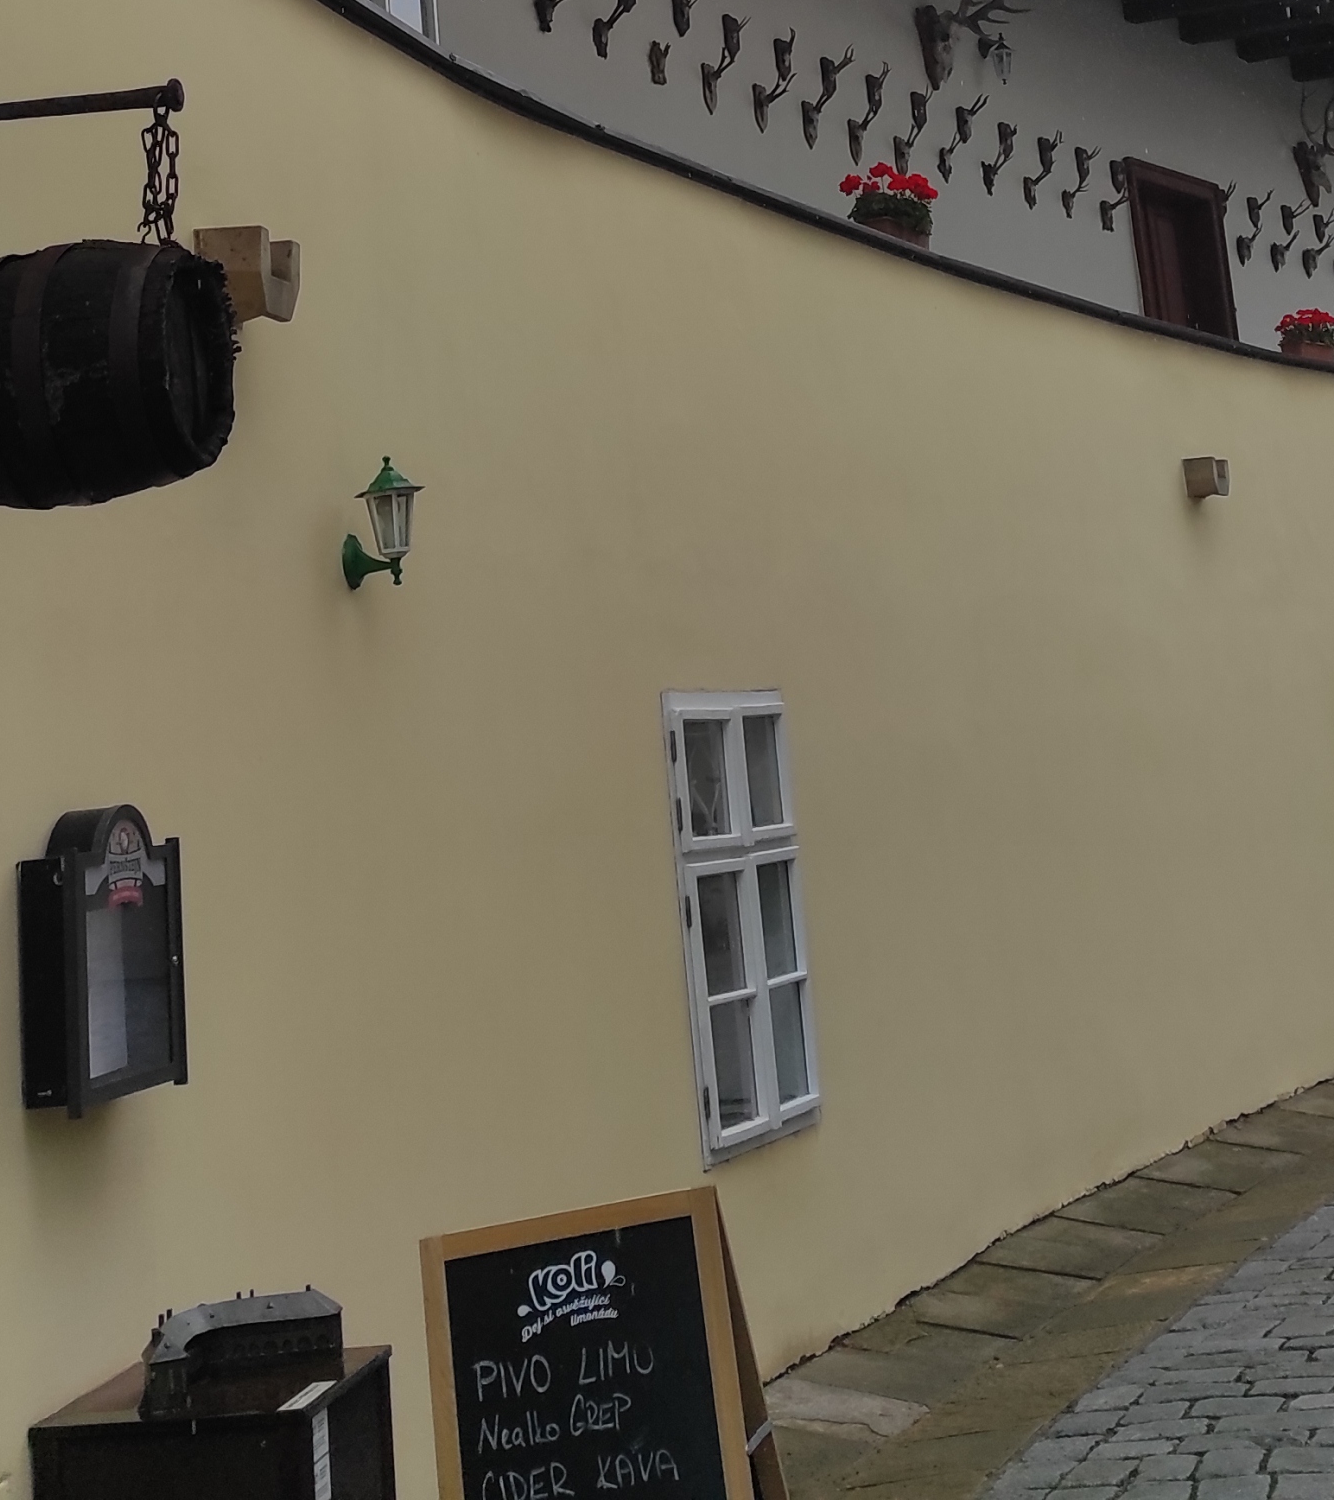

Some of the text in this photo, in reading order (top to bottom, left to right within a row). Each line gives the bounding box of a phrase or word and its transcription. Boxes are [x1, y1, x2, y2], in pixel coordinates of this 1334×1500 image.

[521, 1317, 543, 1343] Dej
[543, 1309, 554, 1326] si
[570, 1308, 619, 1327] limonádu
[472, 1354, 551, 1402] PIVO
[478, 1393, 632, 1454] Nealko GREP
[481, 1461, 575, 1500] CIDER
